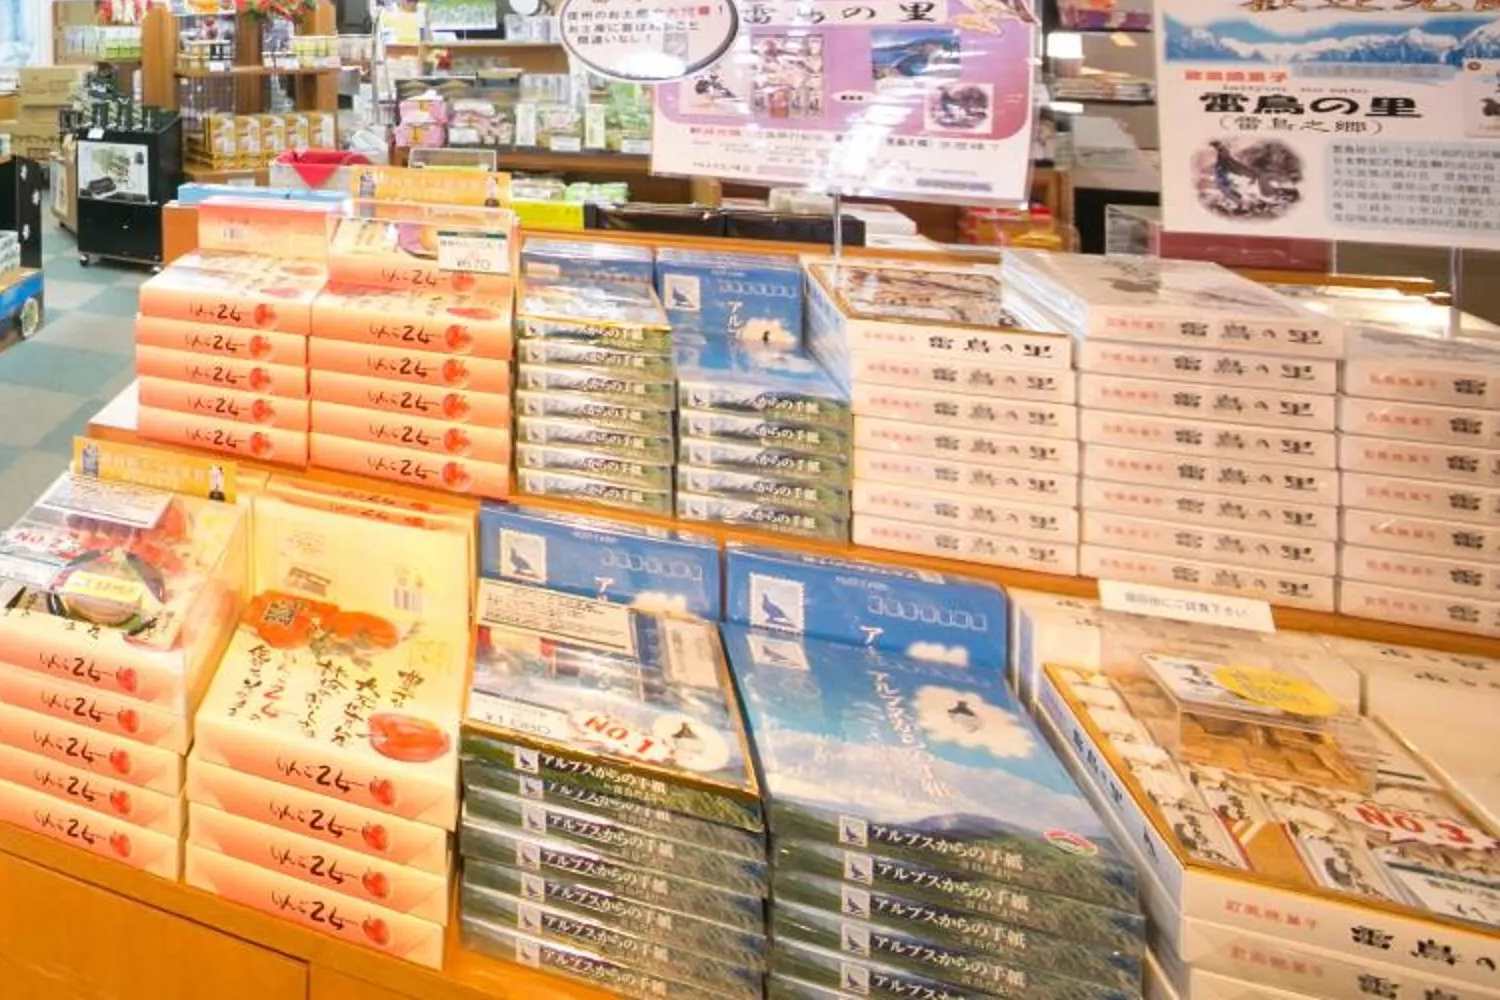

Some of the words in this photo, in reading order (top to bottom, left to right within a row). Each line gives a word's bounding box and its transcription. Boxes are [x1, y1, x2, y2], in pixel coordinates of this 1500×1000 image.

[1199, 92, 1423, 119] 雷鳥の里
[872, 825, 1024, 871] アルプスからの手紙
[878, 863, 1030, 912] アルプスからの手紙
[875, 898, 1027, 949] アルプスからの手紙
[874, 935, 1026, 988] アルプスからの手紙
